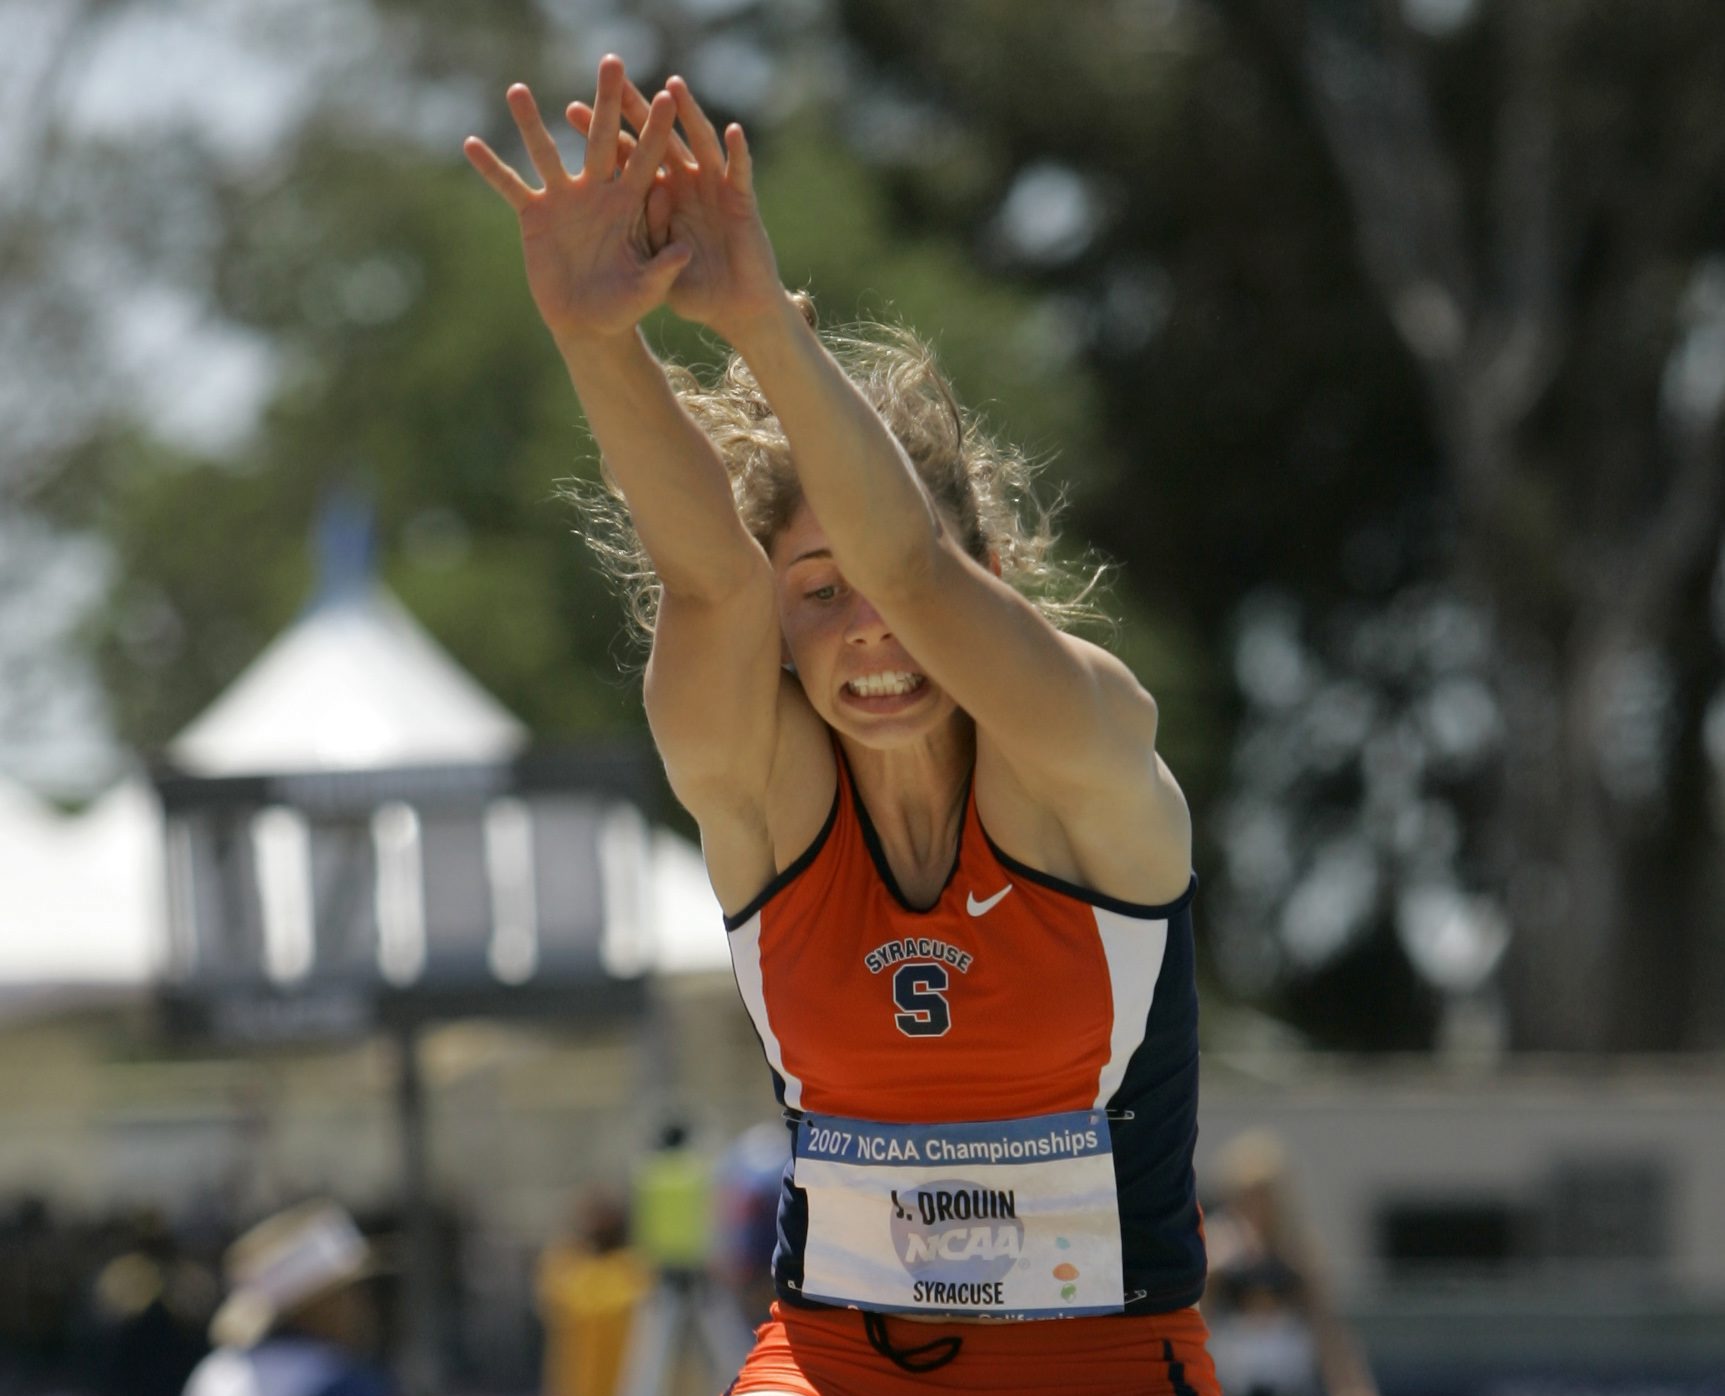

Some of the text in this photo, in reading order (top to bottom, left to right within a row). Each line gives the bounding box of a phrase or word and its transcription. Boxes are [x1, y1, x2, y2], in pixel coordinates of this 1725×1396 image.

[865, 938, 973, 974] SYRACUSE
[893, 963, 951, 1037] S
[808, 1127, 1098, 1163] 2007 NCAA Championships
[917, 1189, 1017, 1226] DROUIN
[905, 1225, 1021, 1264] NCAA
[913, 1280, 1005, 1305] SYRACUSE
